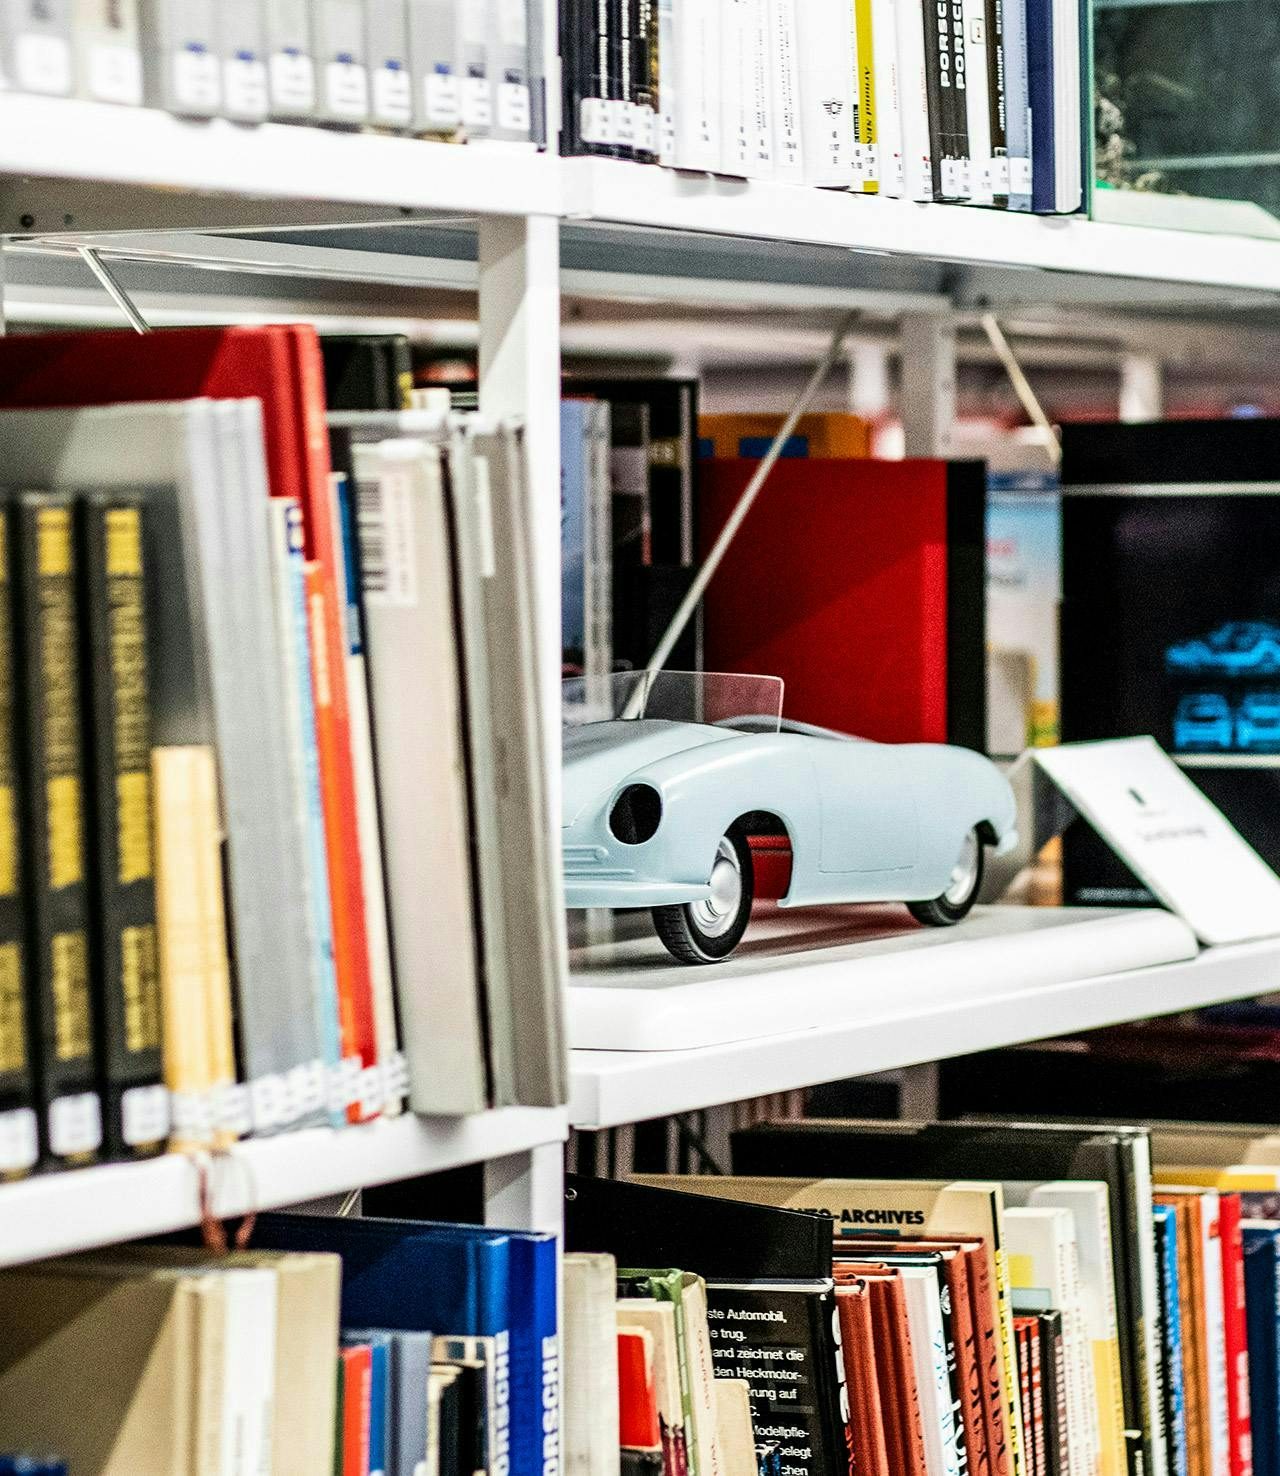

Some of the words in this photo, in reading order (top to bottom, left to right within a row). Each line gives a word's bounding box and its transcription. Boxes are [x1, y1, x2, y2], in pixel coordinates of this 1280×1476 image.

[937, 0, 951, 88] PORSC
[952, 0, 966, 90] PORSC
[726, 1308, 787, 1323] Automobil,
[720, 1328, 748, 1342] trug.
[736, 1347, 785, 1361] zeichnet
[786, 1349, 805, 1362] die
[736, 1366, 803, 1380] Heckmotor-
[778, 1388, 798, 1399] auf
